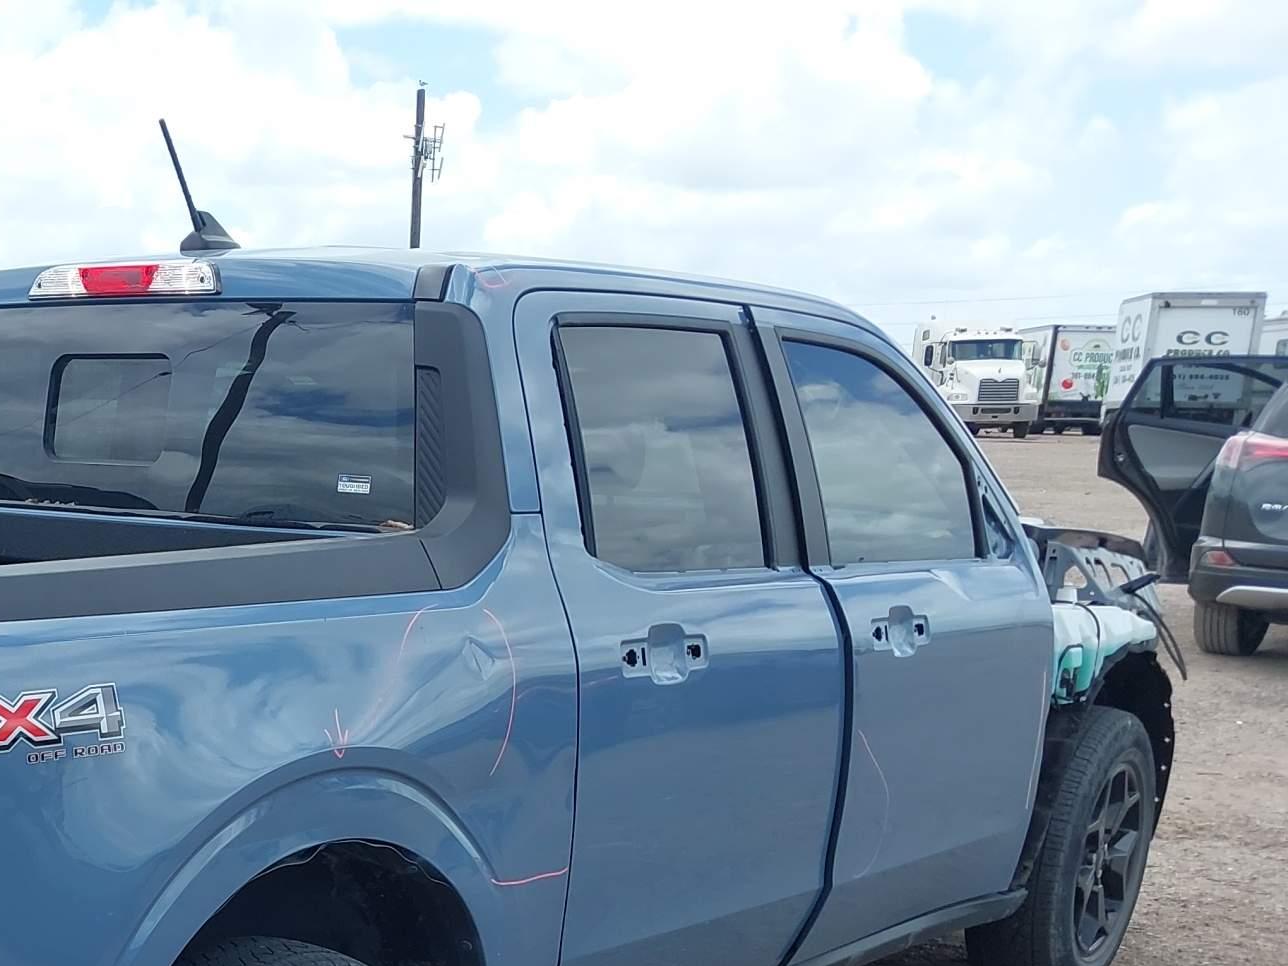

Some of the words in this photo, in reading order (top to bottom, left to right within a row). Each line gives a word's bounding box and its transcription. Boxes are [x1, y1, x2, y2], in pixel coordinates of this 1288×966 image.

[1120, 313, 1143, 343] CC
[1176, 331, 1230, 346] CC
[1073, 352, 1084, 362] CC
[27, 749, 66, 764] OFF
[73, 742, 125, 758] ROAD
